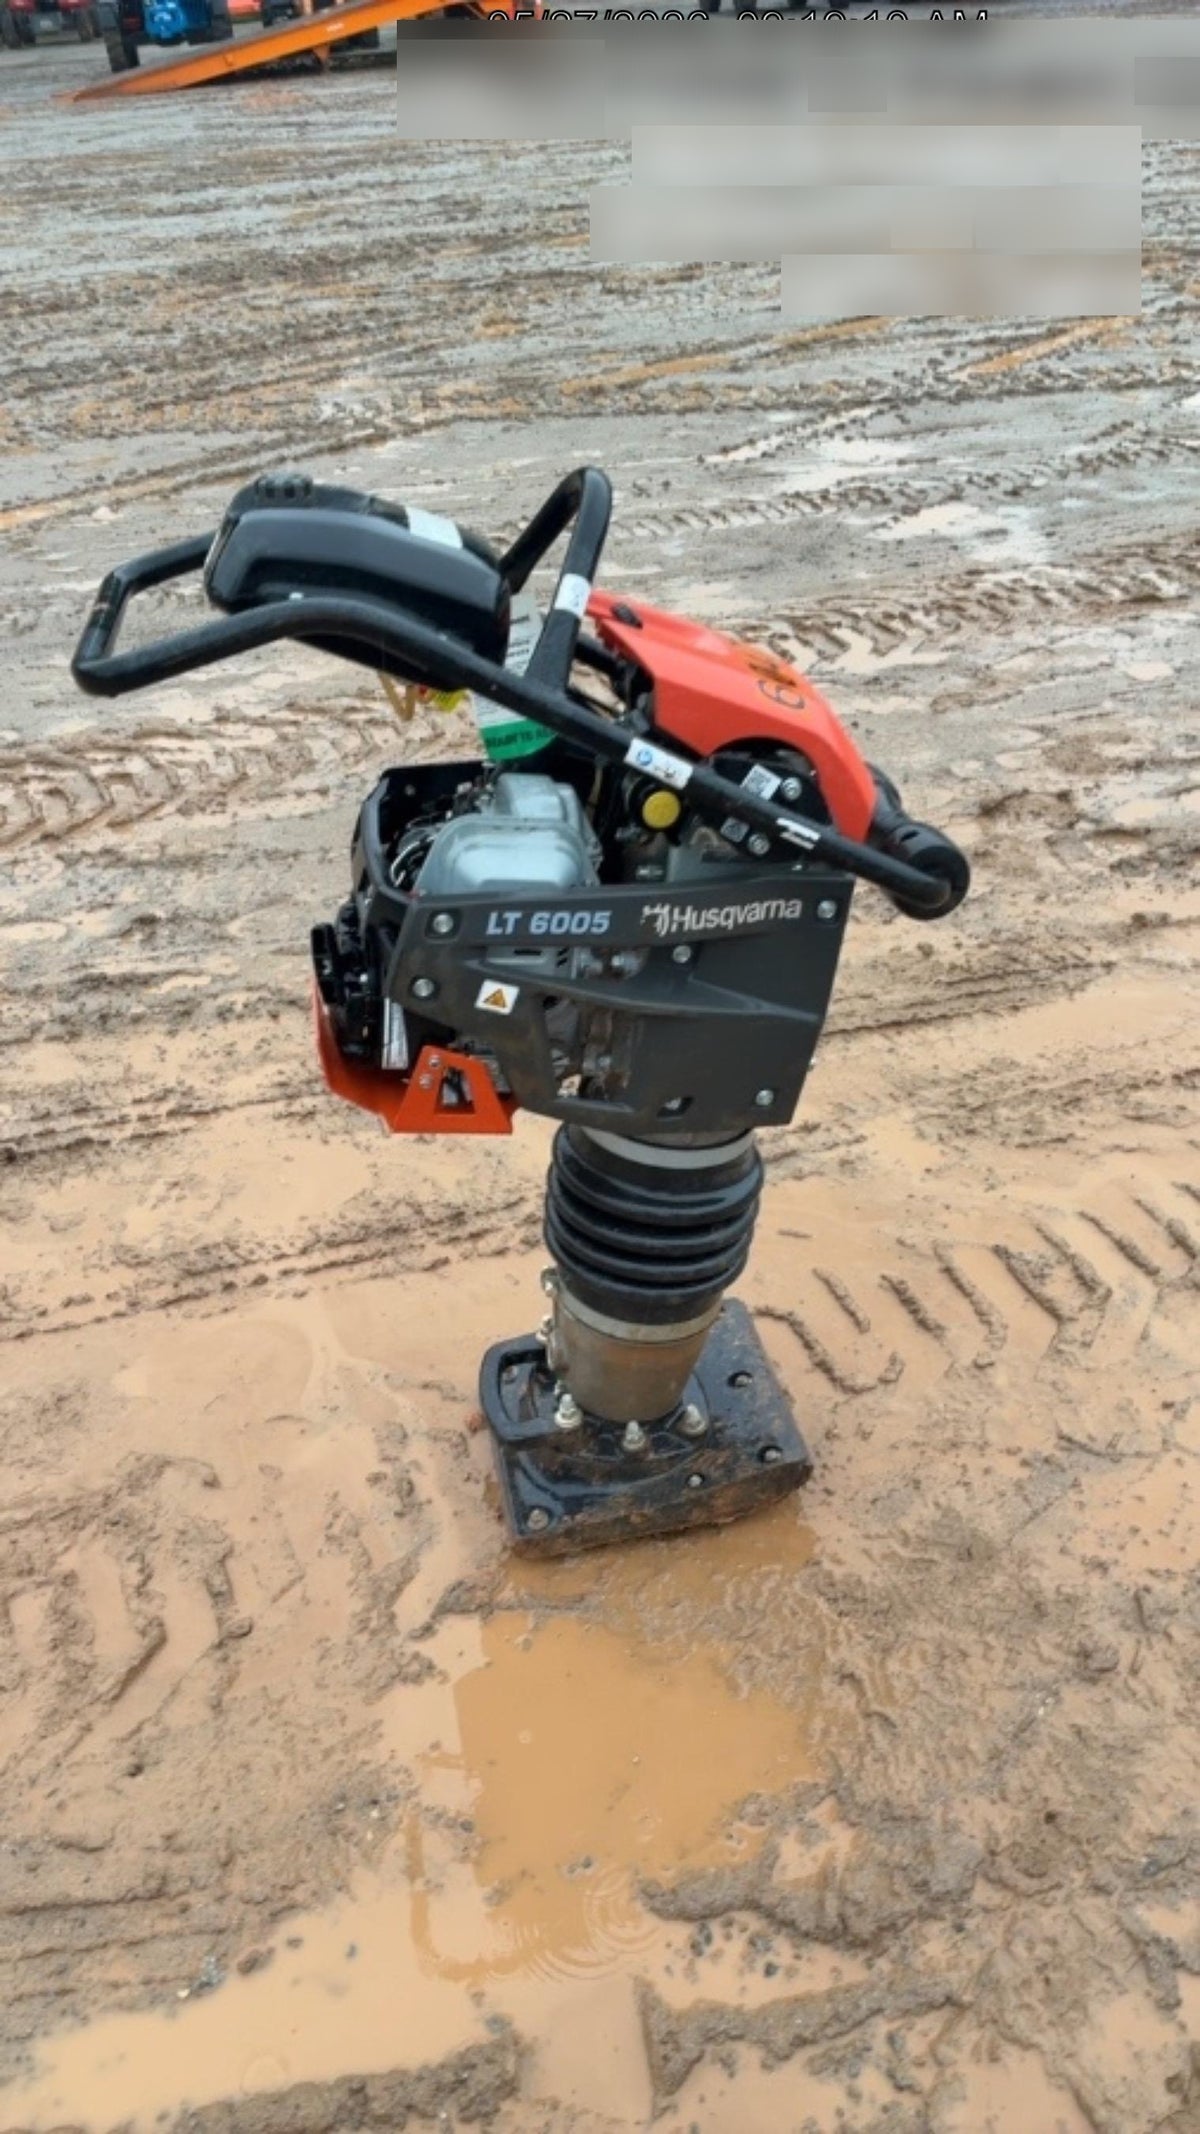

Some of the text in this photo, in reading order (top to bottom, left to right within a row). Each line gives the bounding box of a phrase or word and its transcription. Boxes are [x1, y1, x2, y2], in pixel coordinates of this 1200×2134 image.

[486, 910, 613, 935] LT 6005
[670, 899, 802, 933] Husqvarna
